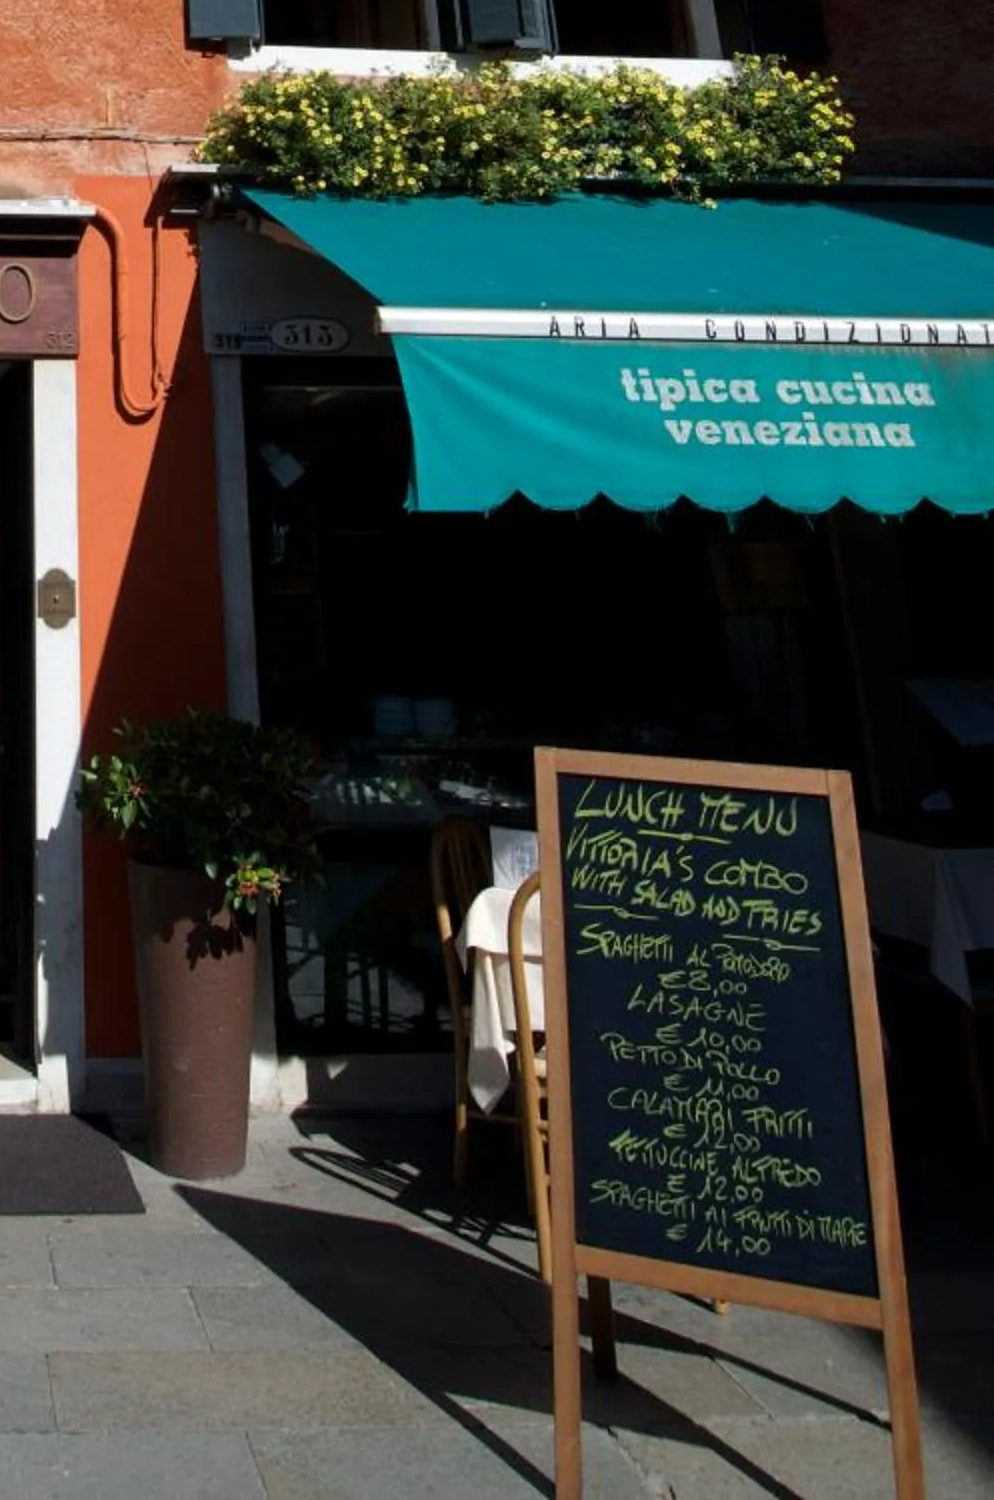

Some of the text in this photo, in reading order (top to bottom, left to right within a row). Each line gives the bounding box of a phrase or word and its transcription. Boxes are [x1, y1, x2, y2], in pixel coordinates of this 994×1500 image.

[548, 315, 641, 340] ARIA
[620, 367, 937, 412] tipica cucina
[663, 411, 917, 447] veneziana
[574, 779, 798, 837] LUNCH MENU
[566, 822, 808, 895] VITTORIA'S COMBO
[572, 862, 823, 935] WITH SALAD AND FRIES
[576, 922, 673, 963] SPAGHETTI
[686, 944, 711, 967] AL
[627, 984, 767, 1031] LASAGNE
[599, 1031, 677, 1065] PETTO
[706, 1050, 781, 1086] POLLO
[607, 1087, 814, 1140] CALAMARI FRITTI
[732, 1154, 822, 1188] ALFREDO
[589, 1178, 696, 1221] SPAGHETTI
[733, 1205, 792, 1236] FRUTTI
[794, 1209, 816, 1240] DI
[817, 1214, 867, 1248] MARE
